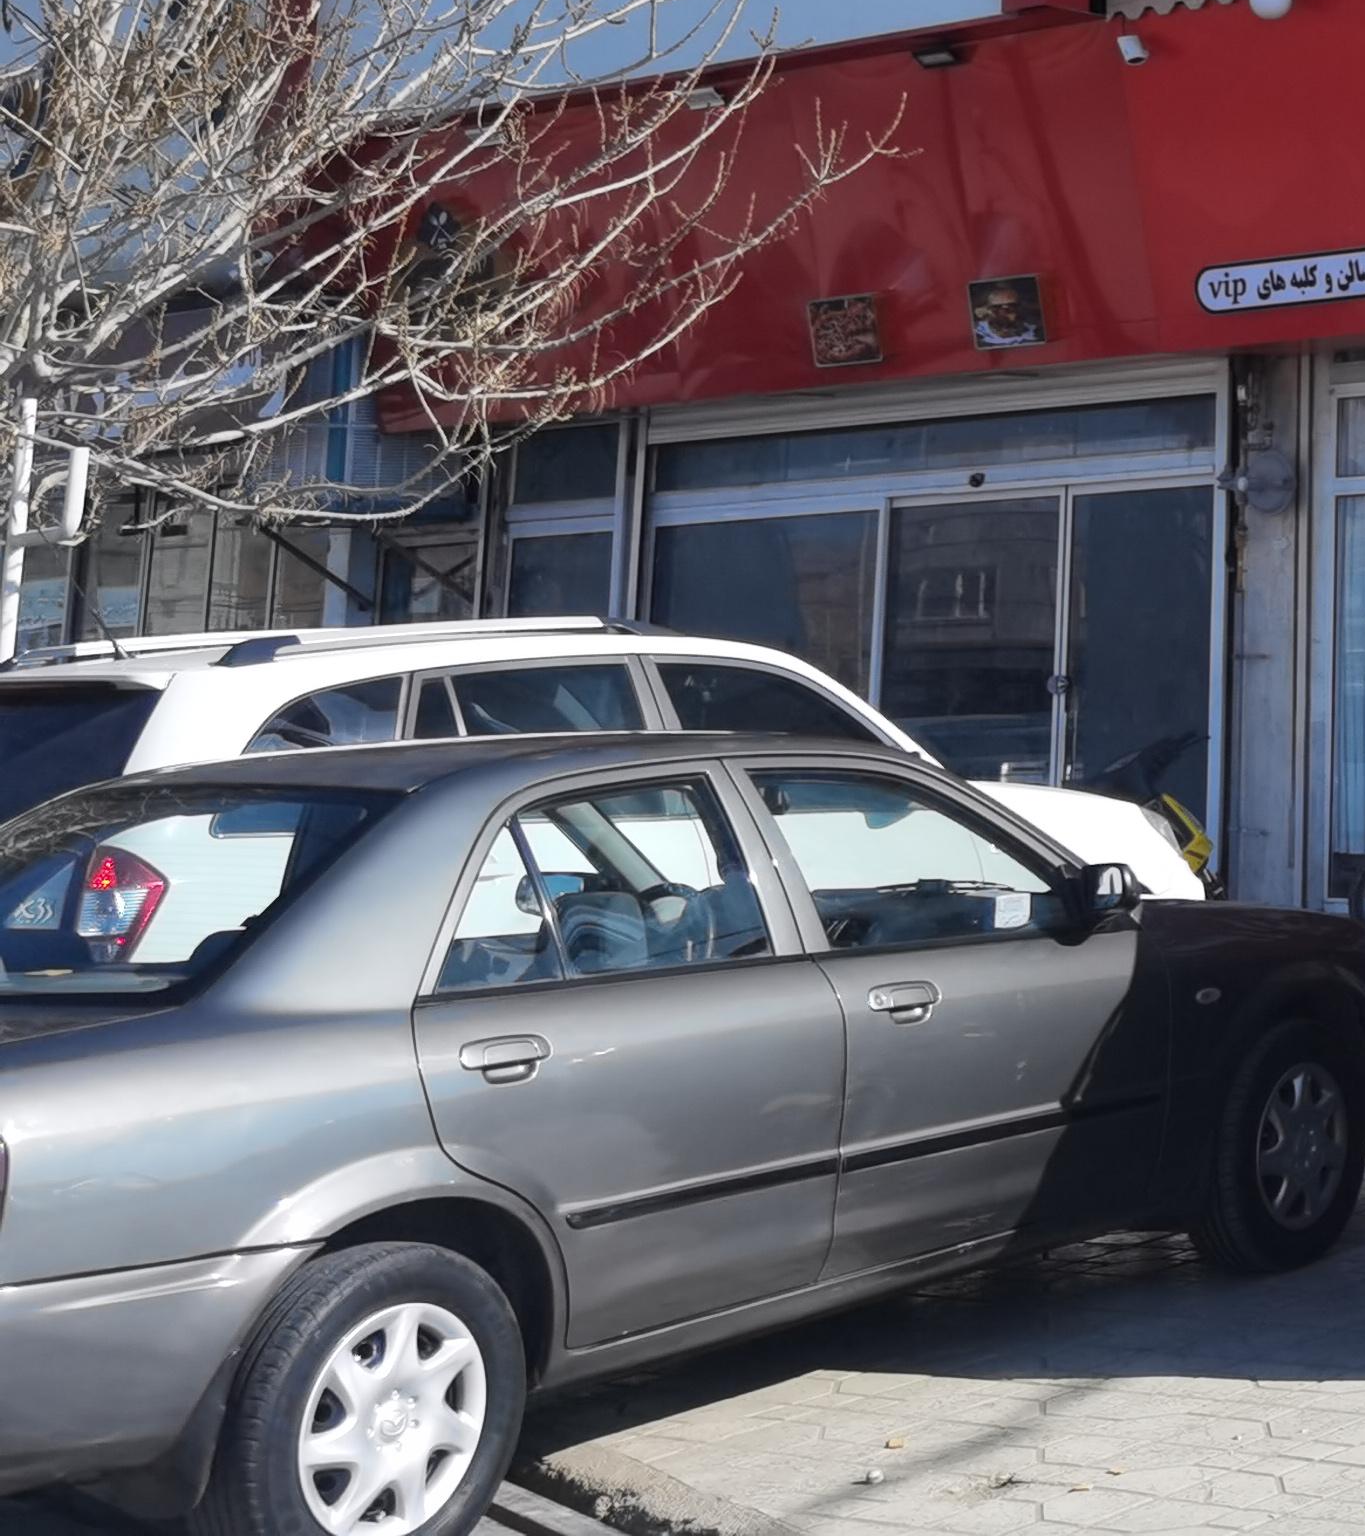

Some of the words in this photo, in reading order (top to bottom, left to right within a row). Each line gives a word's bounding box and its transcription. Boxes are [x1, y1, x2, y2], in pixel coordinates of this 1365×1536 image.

[1208, 272, 1247, 305] vip
[1257, 269, 1287, 300] های
[1290, 264, 1318, 295] کلبه
[1325, 275, 1333, 293] و
